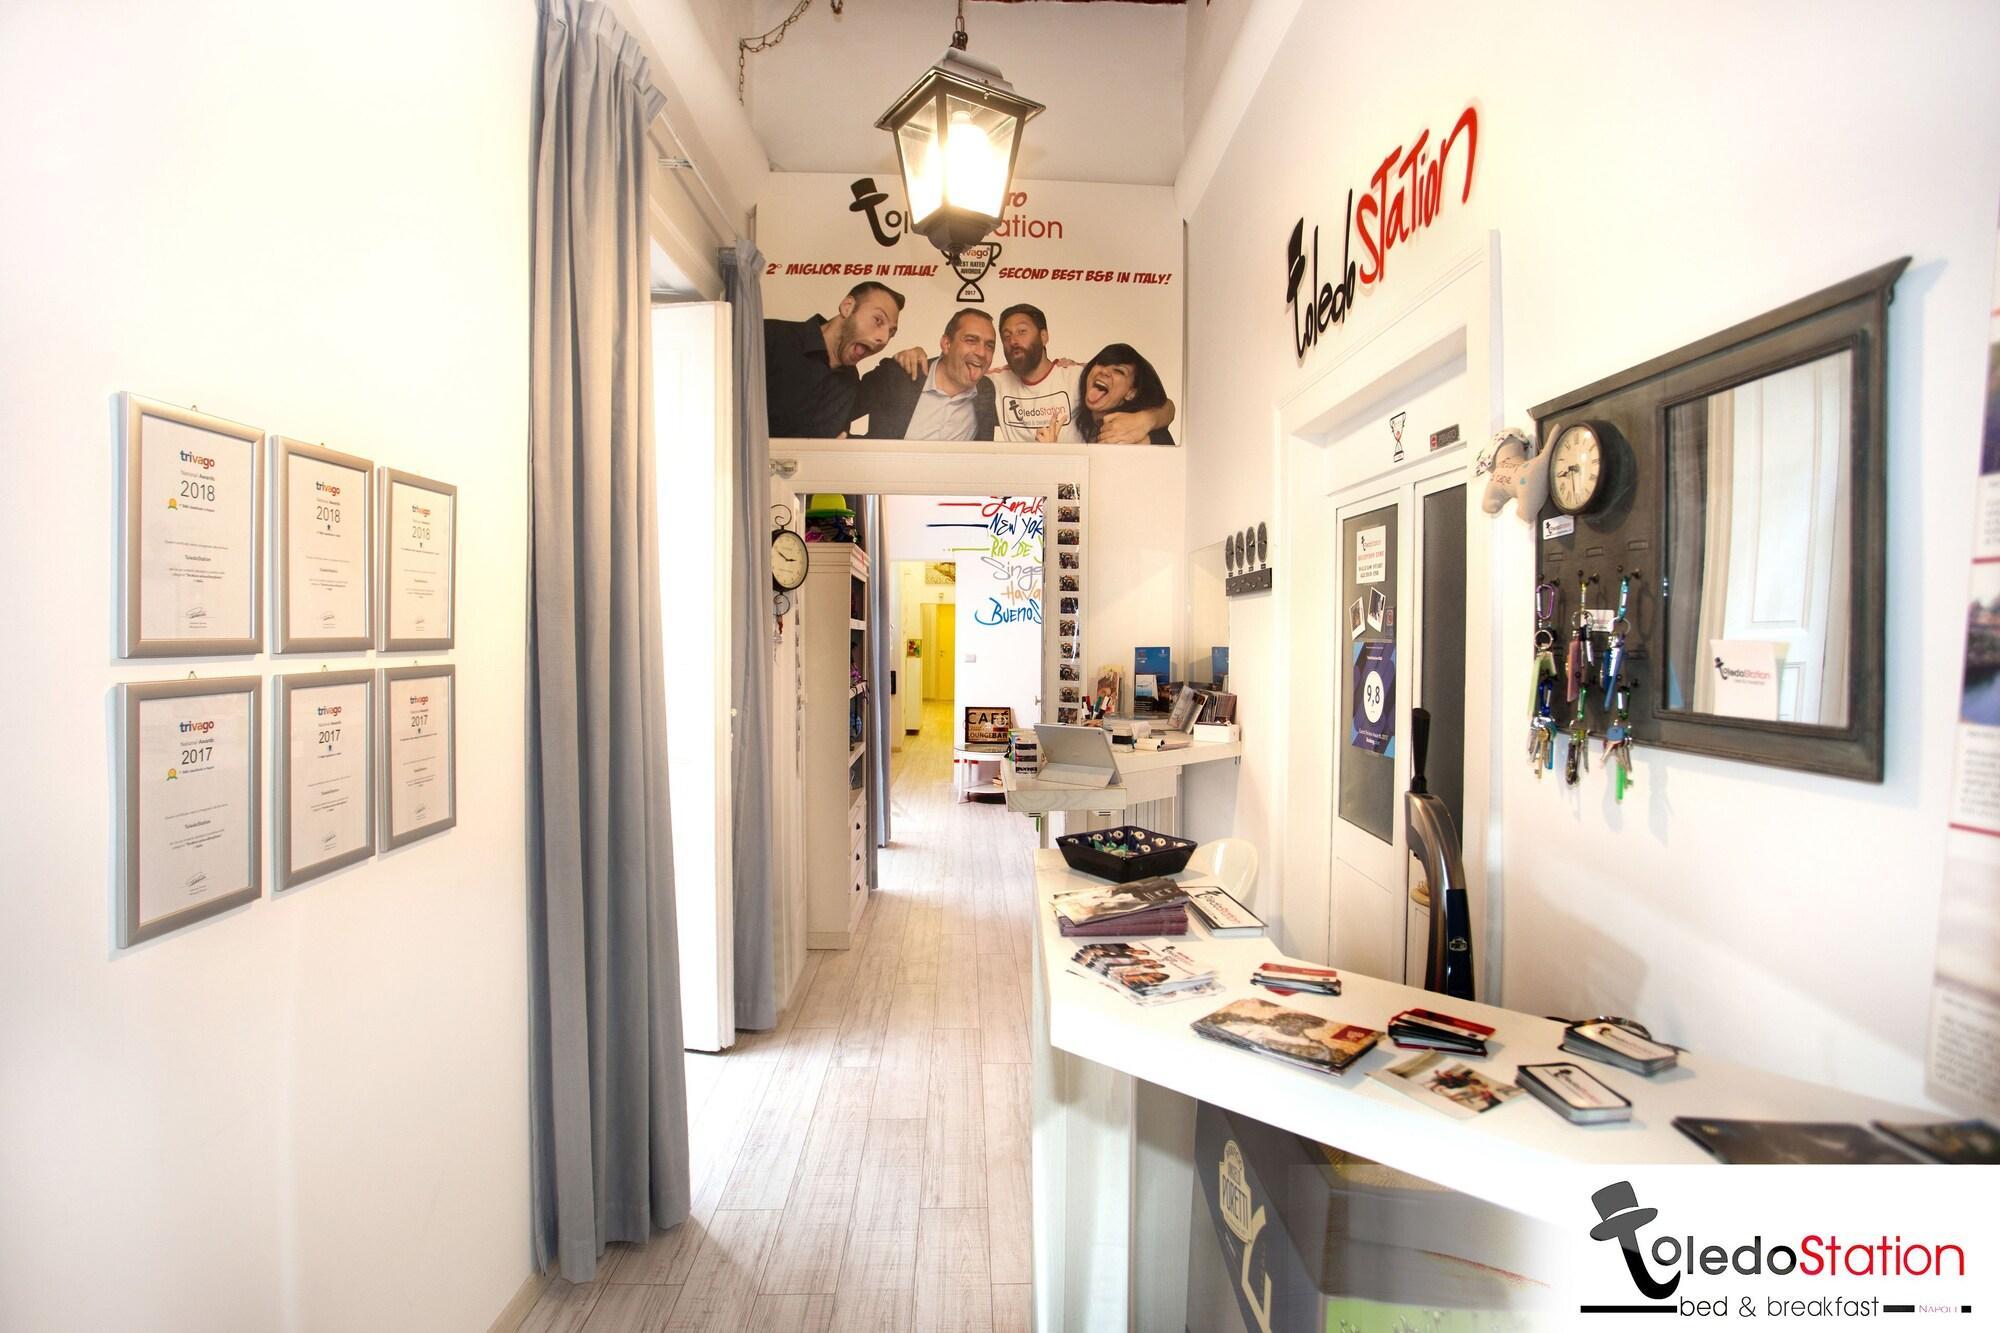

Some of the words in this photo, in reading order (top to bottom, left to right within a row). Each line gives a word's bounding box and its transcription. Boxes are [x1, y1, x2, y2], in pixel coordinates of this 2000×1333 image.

[785, 263, 843, 275] MIGLIOR
[843, 263, 873, 275] B&B
[876, 264, 890, 276] IN
[893, 264, 938, 277] ITALIA!
[998, 267, 1050, 279] SECOND
[1051, 268, 1084, 281] BEST
[1085, 270, 1114, 282] B&B
[1116, 271, 1131, 283] IN
[1133, 272, 1172, 285] ITALY!
[180, 450, 215, 469] trivago
[180, 480, 215, 502] 2018
[316, 481, 341, 496] trivago
[316, 505, 341, 523] 2018
[411, 526, 431, 541] 2018
[410, 695, 429, 705] trivago
[1366, 684, 1381, 707] 9,8
[317, 706, 342, 716] trivago
[179, 720, 215, 734] trivago
[411, 714, 428, 727] 2017
[318, 729, 341, 744] 2017
[181, 746, 213, 765] 2017
